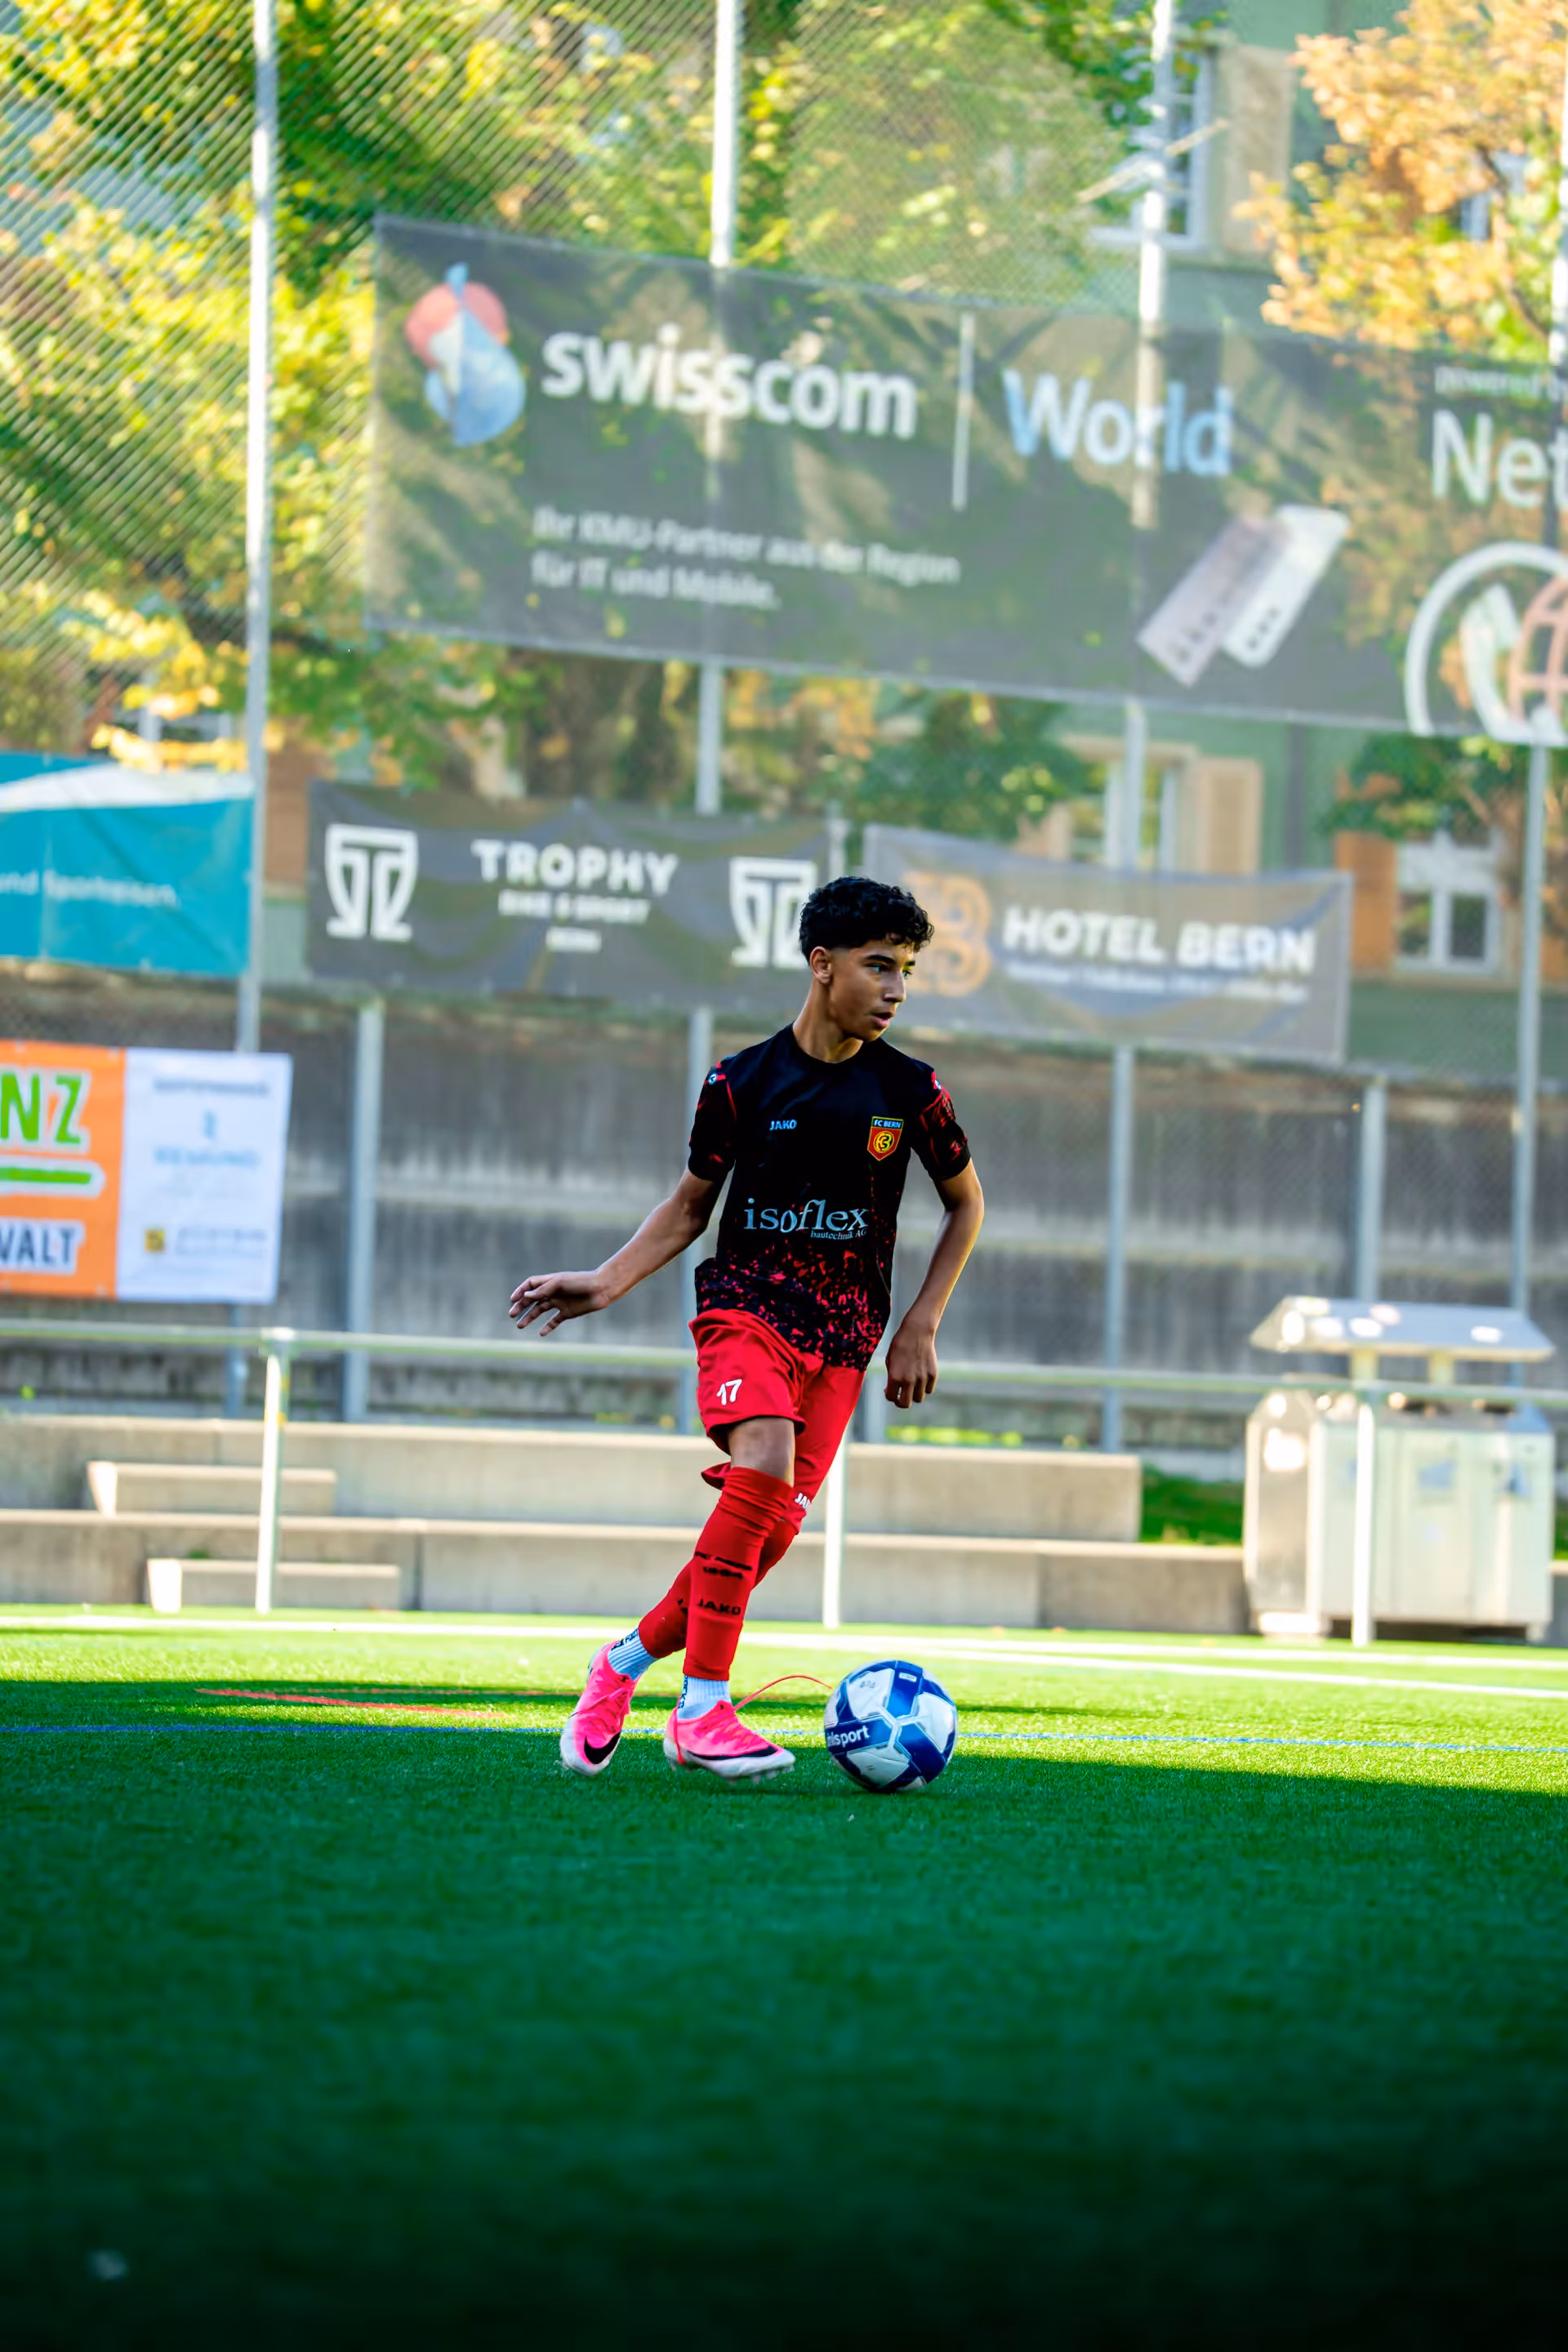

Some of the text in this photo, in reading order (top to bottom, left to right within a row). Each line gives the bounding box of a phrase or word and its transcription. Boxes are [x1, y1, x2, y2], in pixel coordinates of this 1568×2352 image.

[541, 322, 918, 439] swisscom
[1002, 368, 1236, 477] World
[470, 839, 679, 897] TROPHY
[1002, 905, 1316, 976] HOTEL BERN
[769, 1118, 798, 1131] JAKO
[874, 1119, 902, 1129] FC BERN
[744, 1197, 870, 1233] isoflex
[810, 1228, 853, 1241] bautechnik
[716, 1378, 743, 1406] 17
[697, 1597, 742, 1616] JAKO
